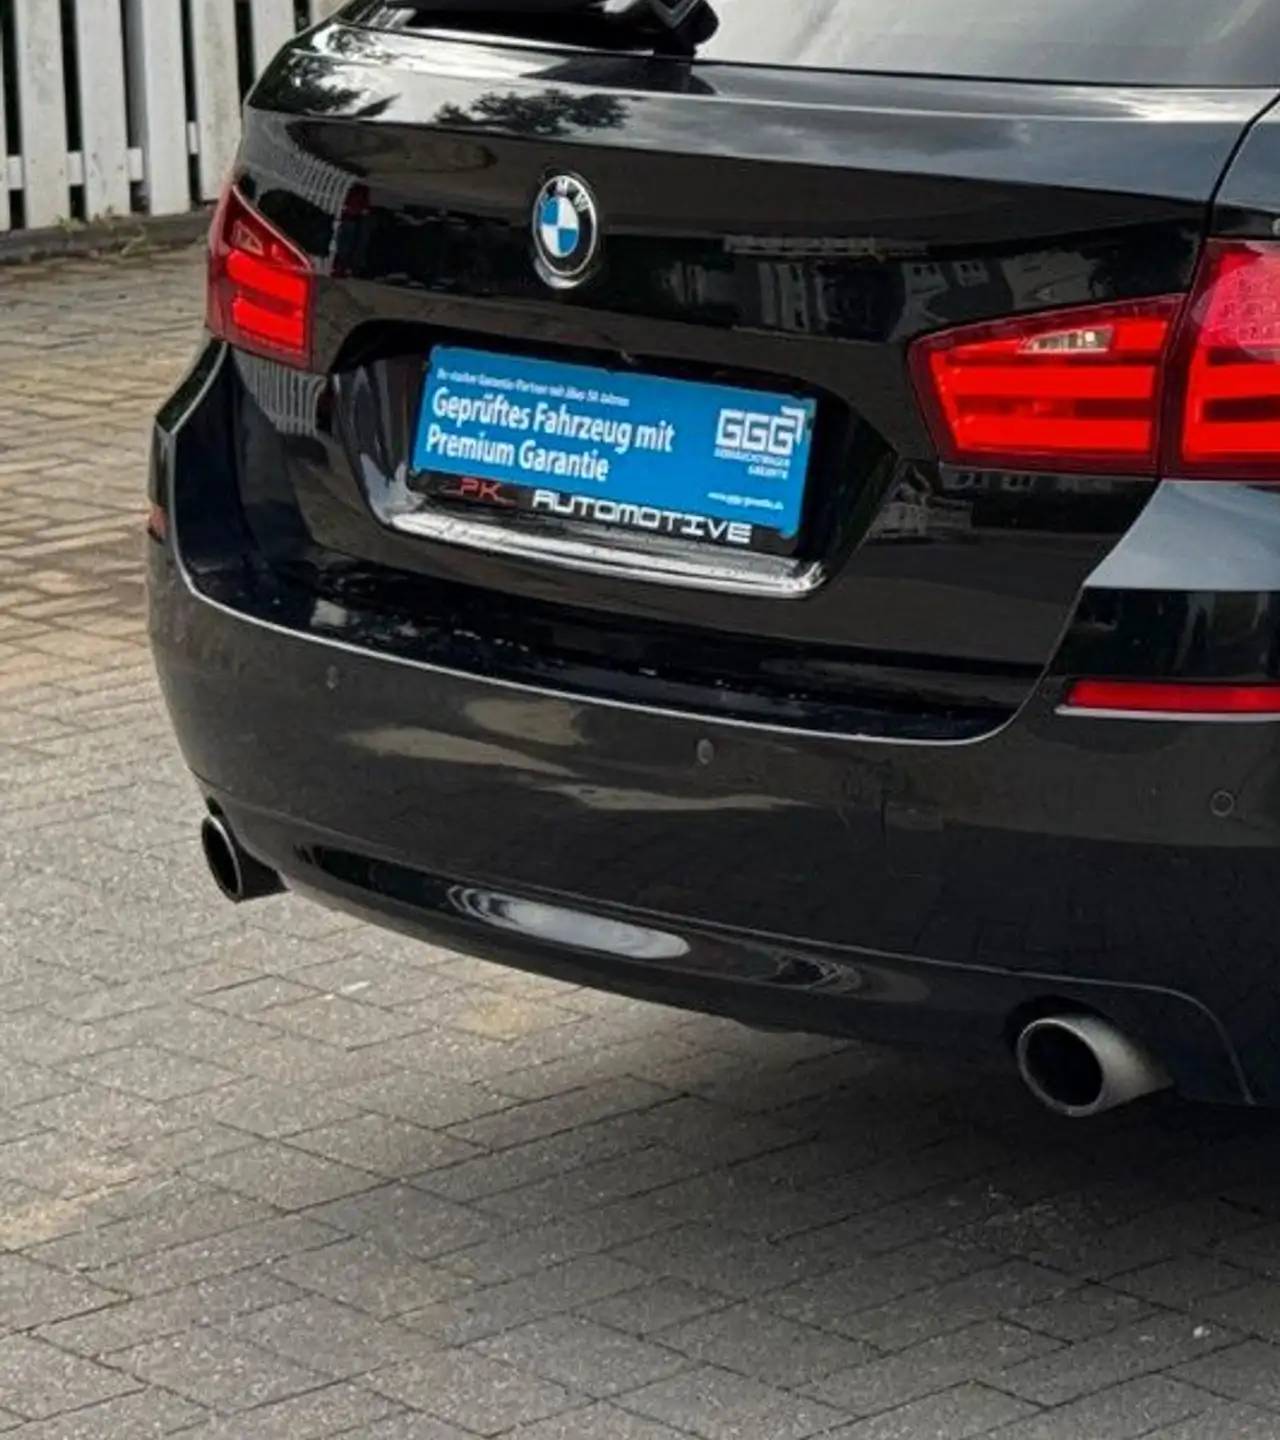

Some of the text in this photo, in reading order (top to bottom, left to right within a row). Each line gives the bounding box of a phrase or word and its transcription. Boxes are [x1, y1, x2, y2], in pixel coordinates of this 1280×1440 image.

[432, 386, 676, 454] Geprüftes Fahrzeug mit
[715, 407, 796, 456] GGG
[425, 423, 609, 482] Premium Garantie
[531, 488, 752, 545] AUTOMOTIVE
